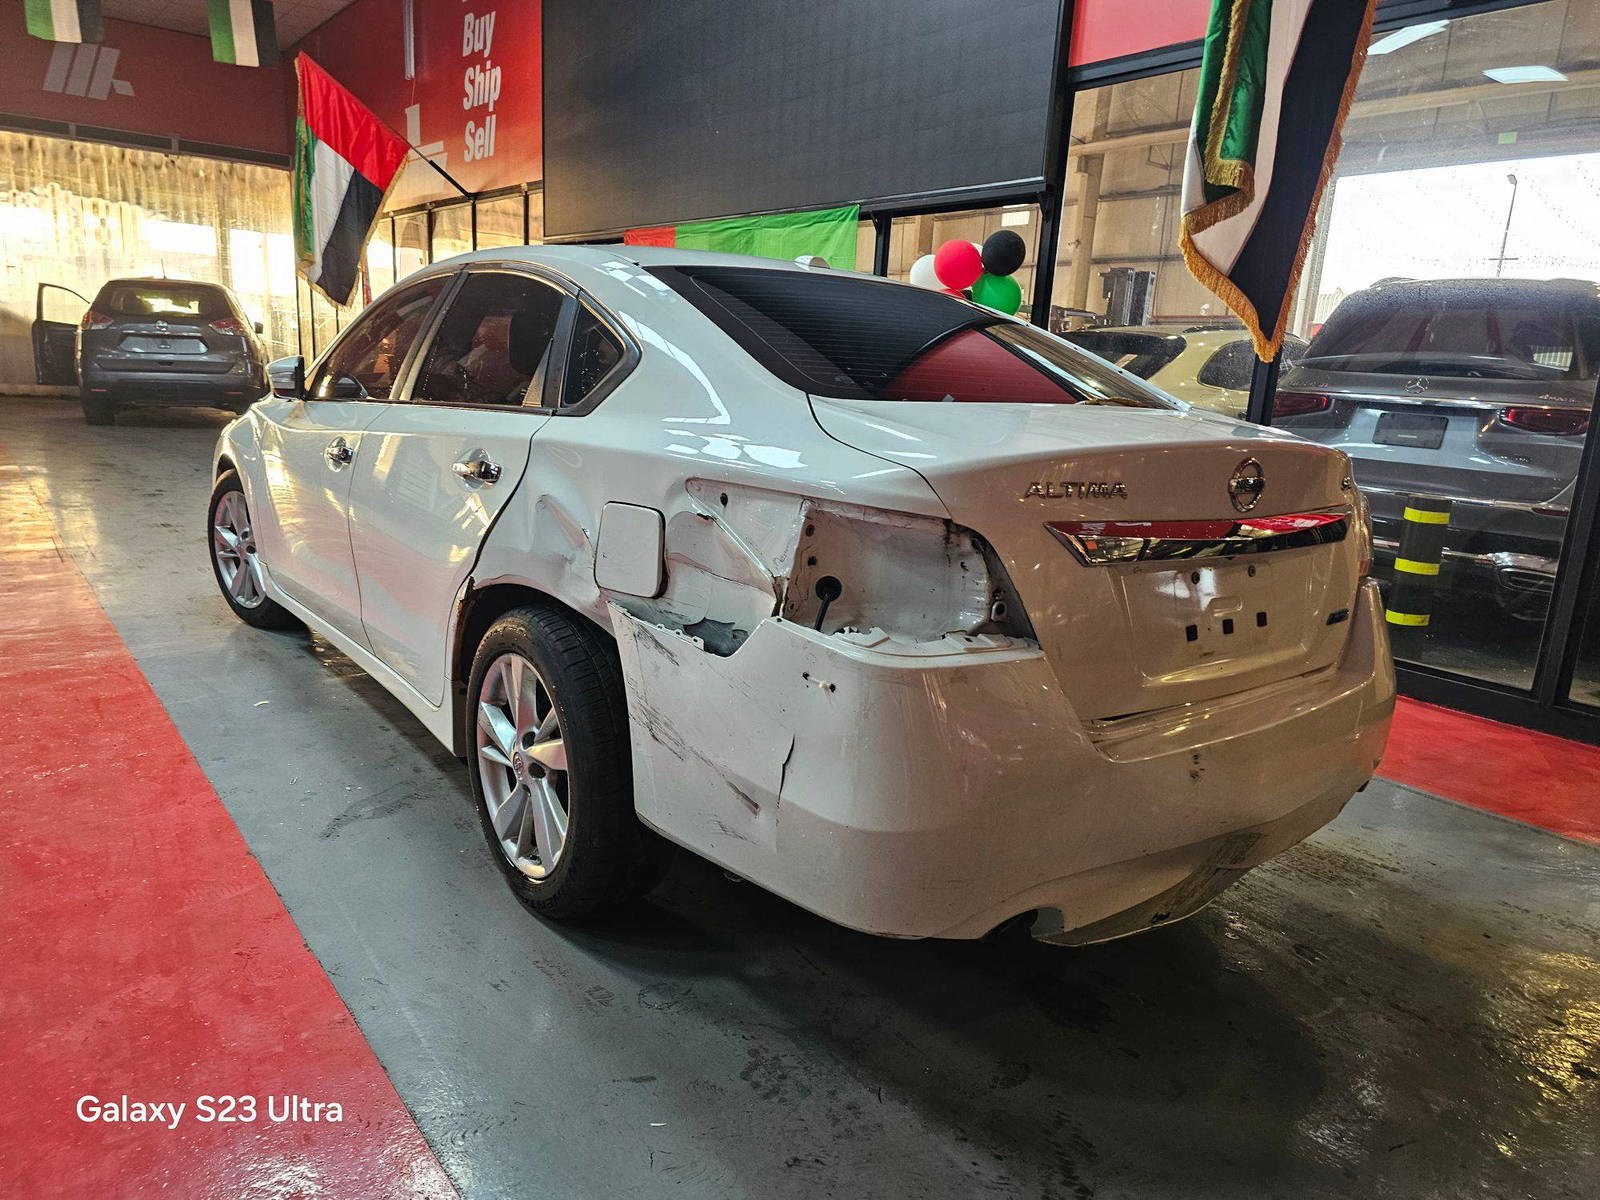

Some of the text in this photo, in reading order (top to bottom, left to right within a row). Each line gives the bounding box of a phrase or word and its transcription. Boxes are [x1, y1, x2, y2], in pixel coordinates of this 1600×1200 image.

[462, 11, 496, 58] Buy
[463, 60, 502, 111] Ship
[464, 114, 496, 162] Sell
[1024, 480, 1128, 499] ALTIMA
